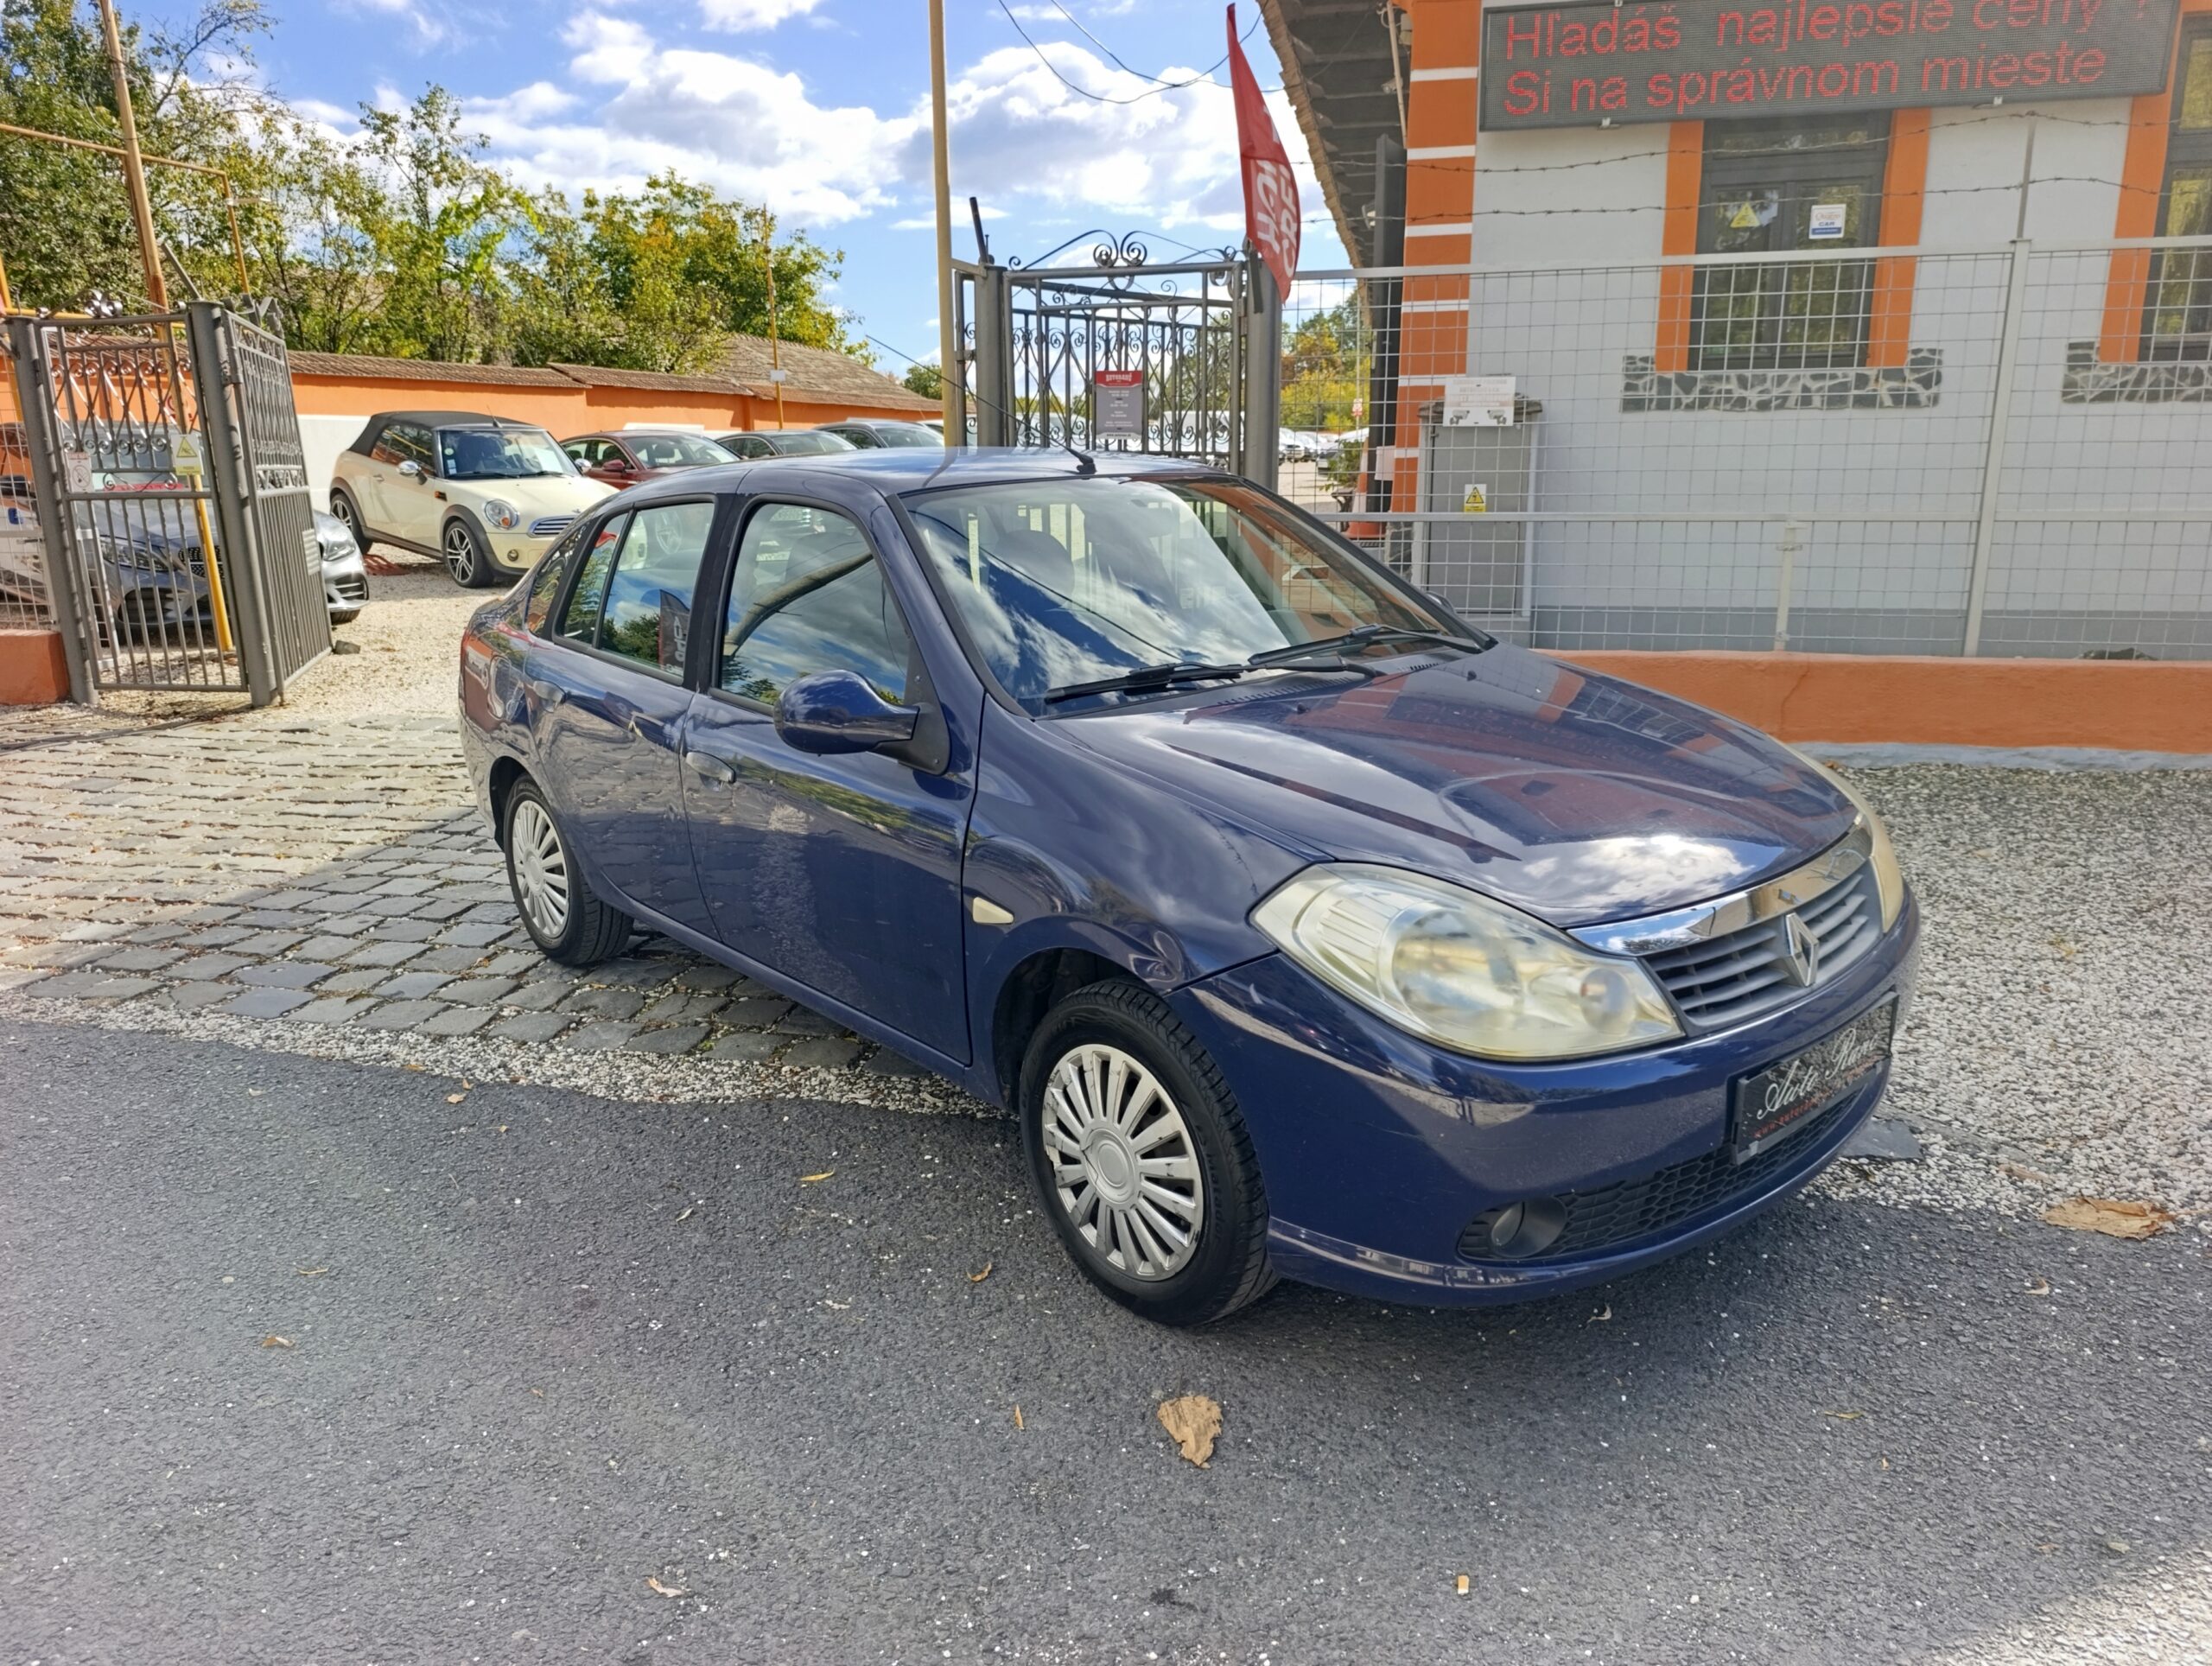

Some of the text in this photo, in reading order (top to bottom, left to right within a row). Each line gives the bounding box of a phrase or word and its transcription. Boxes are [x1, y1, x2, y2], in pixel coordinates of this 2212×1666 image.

[1973, 0, 2102, 33] ceny
[1504, 41, 2107, 115] Si na správnom mieste
